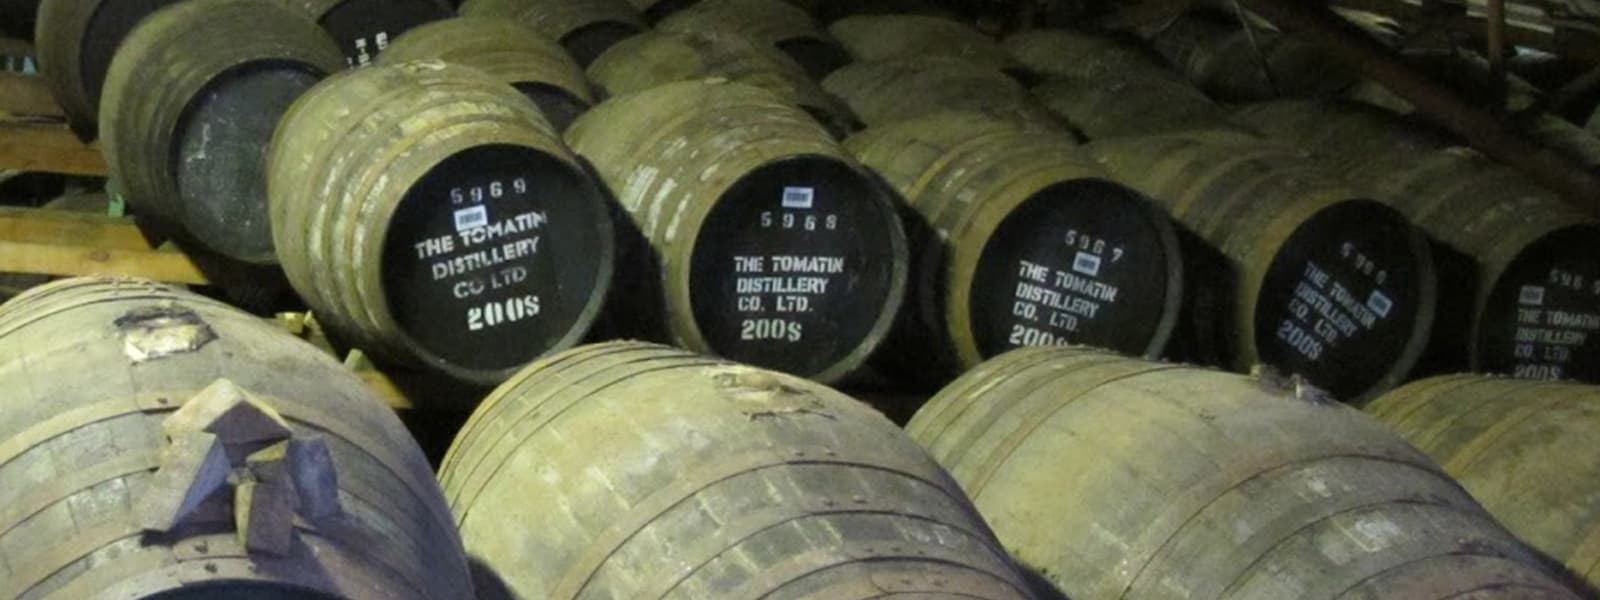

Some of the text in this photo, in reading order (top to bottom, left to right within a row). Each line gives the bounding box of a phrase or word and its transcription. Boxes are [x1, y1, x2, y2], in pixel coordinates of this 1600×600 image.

[451, 178, 526, 204] 5969
[415, 211, 548, 259] THE TOMATIN
[432, 236, 539, 280] DISTILLERY
[734, 256, 844, 273] THE TOMATIN
[491, 266, 527, 289] LTD
[736, 277, 829, 294] DISTILLERY
[1019, 260, 1119, 303] THE TOMATIN
[738, 296, 813, 312] CO. LTD.
[1015, 281, 1100, 318] DISTILLERY
[1295, 281, 1358, 337] DISTILLERY
[1304, 260, 1377, 330] THE TOMATIN
[1013, 301, 1039, 321] CO.
